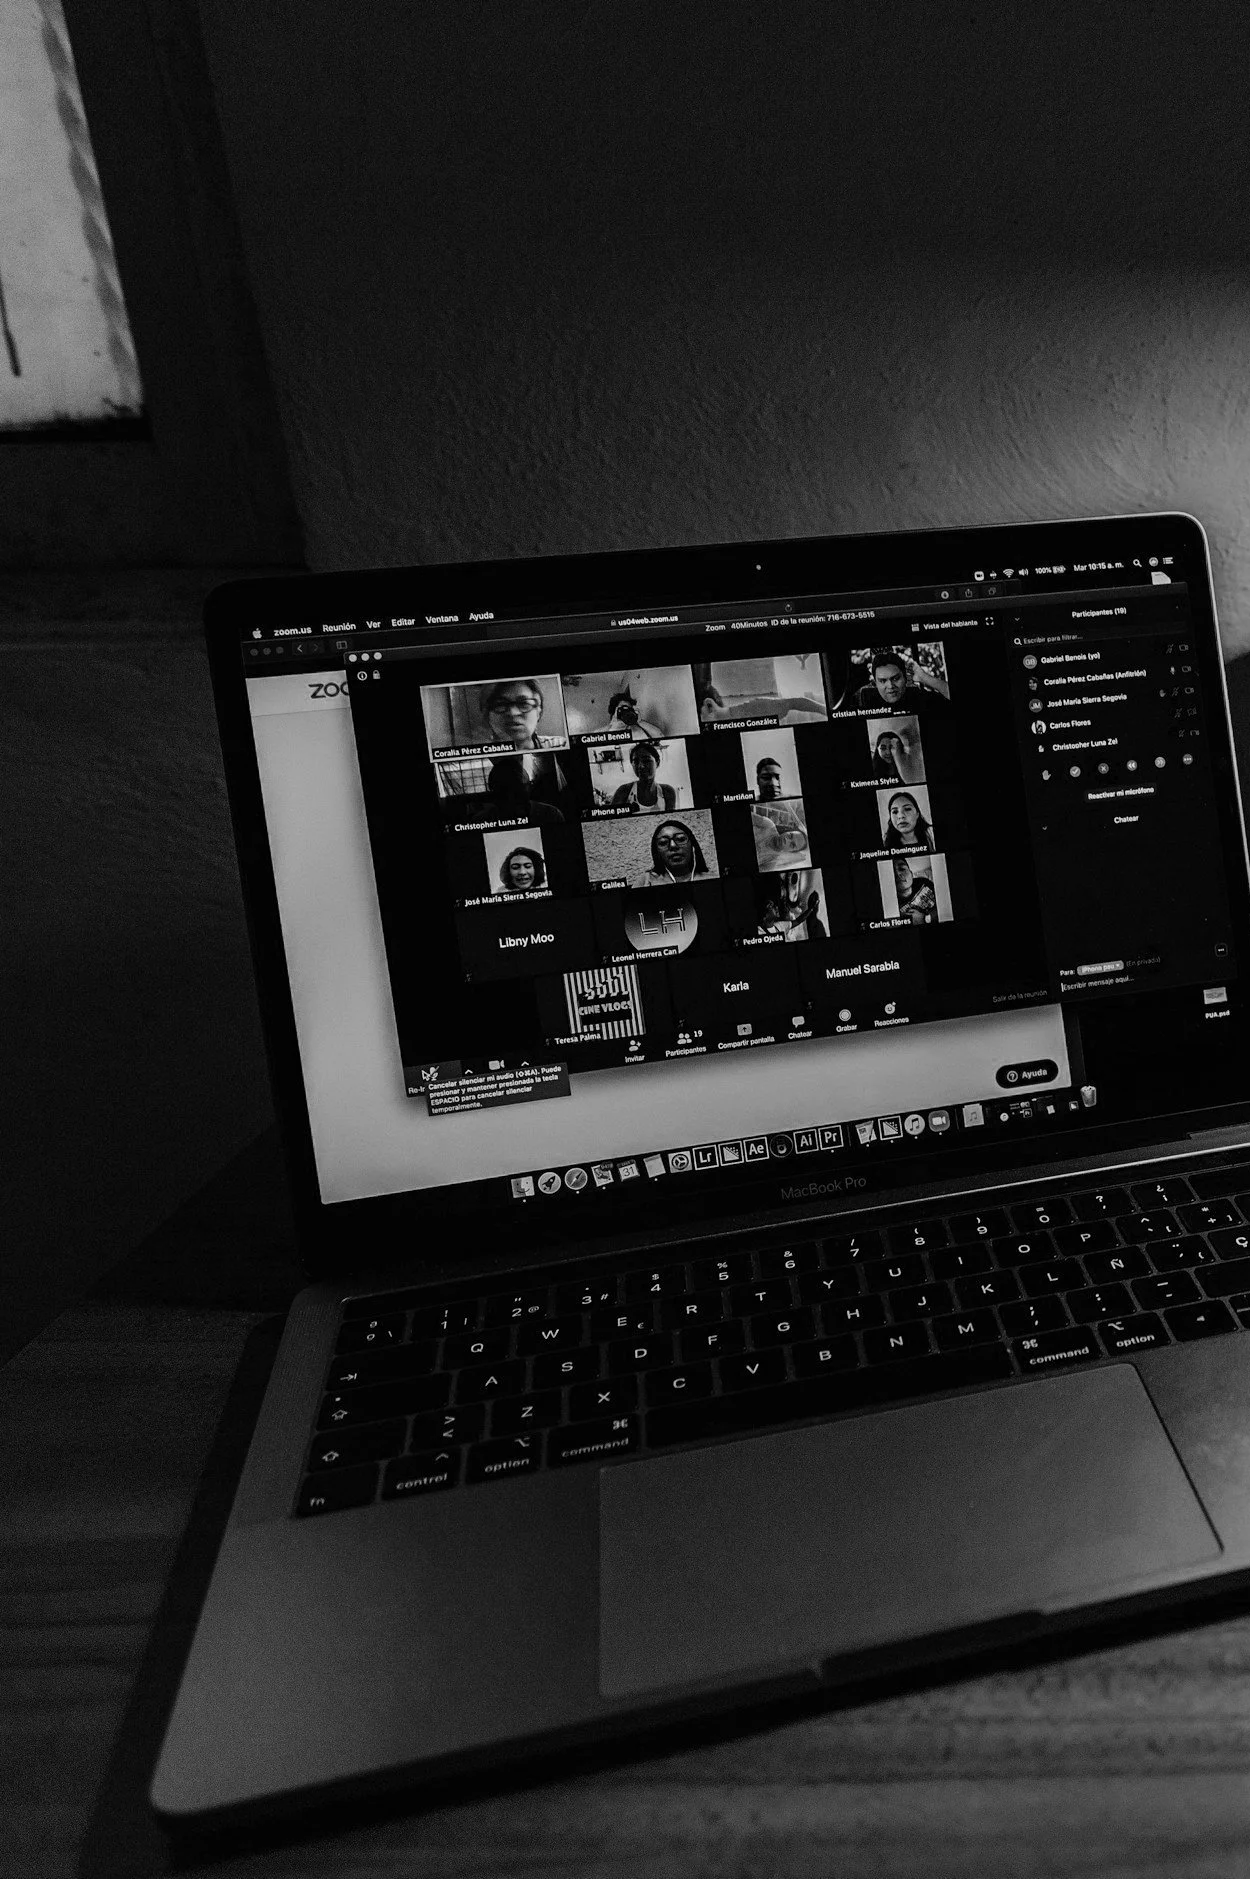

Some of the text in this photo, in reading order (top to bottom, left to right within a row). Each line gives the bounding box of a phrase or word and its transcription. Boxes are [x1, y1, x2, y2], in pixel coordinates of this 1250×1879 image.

[1035, 566, 1051, 574] 100%
[425, 614, 459, 624] Ventana
[469, 612, 494, 621] Ayuda
[1072, 609, 1112, 619] Participantes
[366, 620, 380, 629] Ver
[391, 618, 415, 627] Editar
[618, 614, 678, 626] us04web.zoom.us
[273, 627, 312, 637] zoom.us
[323, 623, 356, 633] Reunión
[1041, 654, 1064, 664] Gabriel
[1088, 652, 1100, 661] (yo)
[1044, 676, 1066, 686] Coralia
[1067, 675, 1085, 683] Pérez
[832, 710, 856, 718] cristian
[857, 707, 892, 716] hernandez
[714, 718, 777, 730] Francisco González
[1050, 719, 1091, 729] Carlos Flores
[581, 732, 630, 743] Gabriel Benois
[434, 743, 513, 758] Coralia Pérez Cabañas
[880, 777, 899, 786] Styles
[592, 807, 629, 816] iPhone pau
[1114, 815, 1139, 824] Chatear
[455, 820, 497, 833] Christopher
[499, 818, 516, 826] Luna
[860, 849, 889, 859] Jaqueline
[601, 881, 625, 889] Galilea
[464, 898, 480, 907] José
[503, 893, 524, 901] Sierra
[526, 889, 552, 900] Segovia
[870, 917, 911, 929] Carlos Flores
[499, 933, 554, 949] Libny Moo
[743, 934, 783, 945] Pedro Ojeda
[612, 948, 676, 963] Leonel Herrera Can
[826, 960, 900, 979] Manuel Sarabia
[723, 981, 750, 993] Karla
[1205, 1010, 1230, 1019] PUA.psd
[874, 1017, 909, 1027] Reacciones
[836, 1023, 858, 1033] Grabar
[554, 1033, 601, 1045] Teresa Palma
[693, 1030, 703, 1038] 19
[788, 1030, 812, 1040] Chatear
[718, 1035, 775, 1050] Compartir pantalla
[665, 1045, 706, 1057] Participantes
[625, 1055, 645, 1063] Invitar
[1022, 1068, 1047, 1080] Ayuda
[430, 1089, 460, 1099] presionar
[467, 1085, 497, 1093] mantener
[499, 1079, 534, 1090] presionada
[542, 1074, 558, 1082] tecla
[431, 1097, 460, 1106] ESPACIO
[477, 1091, 505, 1099] cancelar
[506, 1086, 532, 1095] silenciar
[432, 1102, 482, 1114] temporalmente.
[800, 1134, 813, 1148] Ai
[824, 1130, 838, 1144] Pr
[750, 1140, 764, 1156] Ae
[700, 1150, 712, 1164] Lr
[623, 1166, 635, 1177] 31
[780, 1177, 866, 1200] MacBook Pro
[977, 1226, 988, 1234] 9
[915, 1237, 925, 1246] 8
[1080, 1233, 1091, 1243] P
[850, 1249, 859, 1258] 7
[785, 1260, 795, 1269] 6
[718, 1272, 729, 1281] 5
[889, 1268, 901, 1277] U
[651, 1284, 661, 1292] 4
[823, 1279, 834, 1290] Y
[581, 1295, 592, 1305] 3
[755, 1292, 766, 1302] T
[511, 1308, 522, 1317] 2
[686, 1305, 698, 1314] R
[617, 1317, 627, 1327] E
[542, 1329, 559, 1340] W
[1116, 1334, 1155, 1348] option
[470, 1343, 484, 1353] Q
[1029, 1347, 1089, 1365] command
[561, 1361, 573, 1372] S
[485, 1375, 498, 1386] A
[561, 1438, 629, 1457] command
[485, 1457, 530, 1473] option
[396, 1473, 448, 1490] control
[310, 1497, 325, 1506] fn
